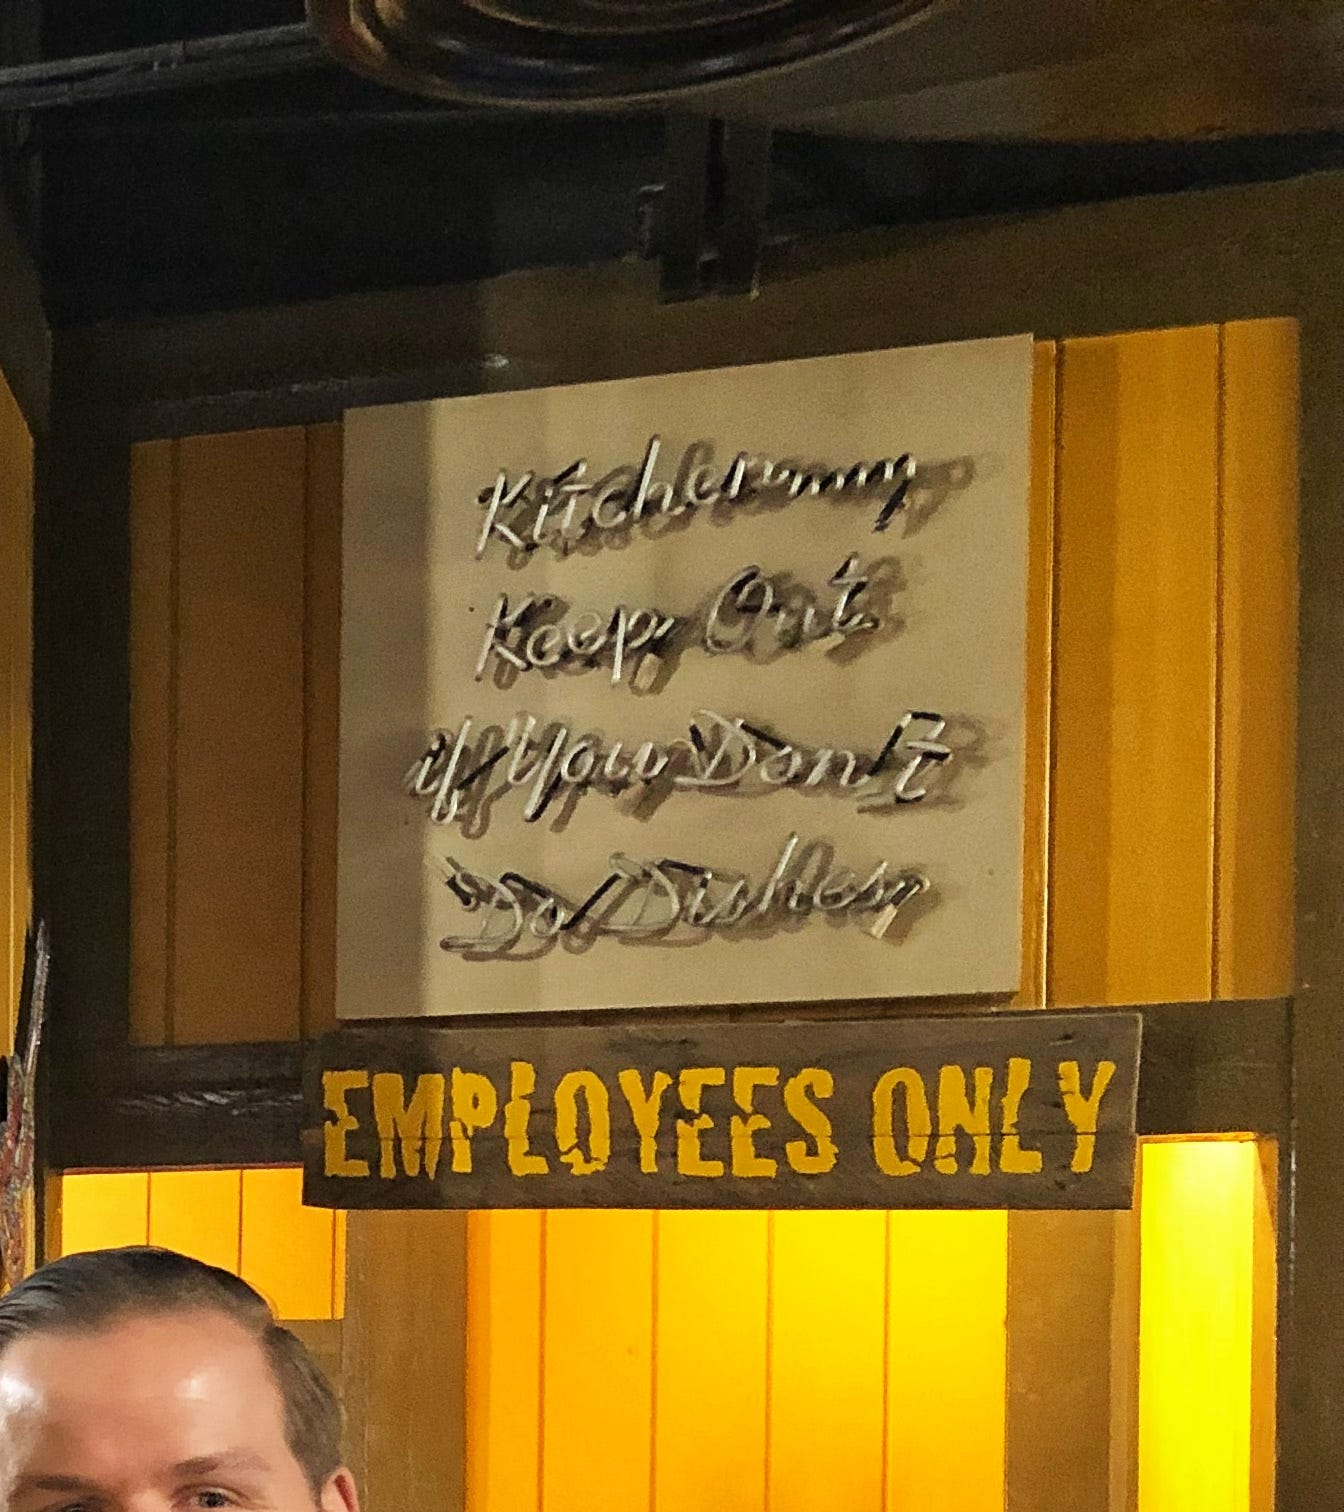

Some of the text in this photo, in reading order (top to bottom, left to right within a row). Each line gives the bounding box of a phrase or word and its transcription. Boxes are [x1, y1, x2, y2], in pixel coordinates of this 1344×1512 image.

[475, 552, 887, 685] Keep Out
[507, 713, 670, 823] You
[322, 1057, 1117, 1181] EMPLOYEES ONLY
